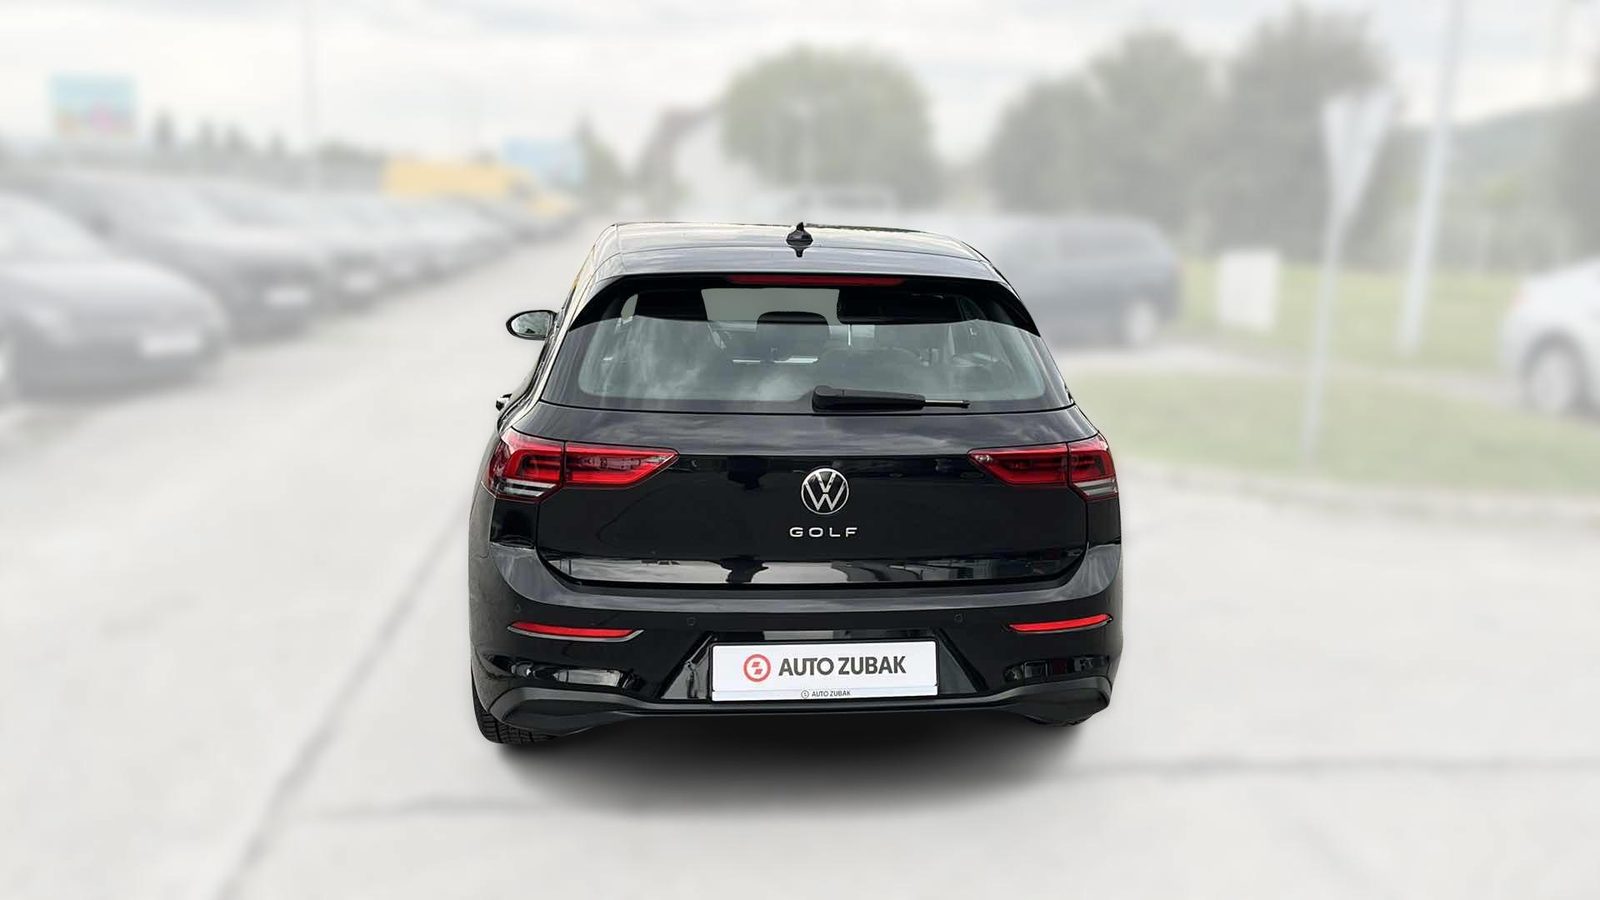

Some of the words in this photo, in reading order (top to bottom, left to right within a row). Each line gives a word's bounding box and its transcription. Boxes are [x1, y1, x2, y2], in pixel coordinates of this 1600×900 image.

[789, 527, 858, 538] GOLF
[778, 657, 835, 677] AUTO
[838, 655, 907, 675] ZUBAK
